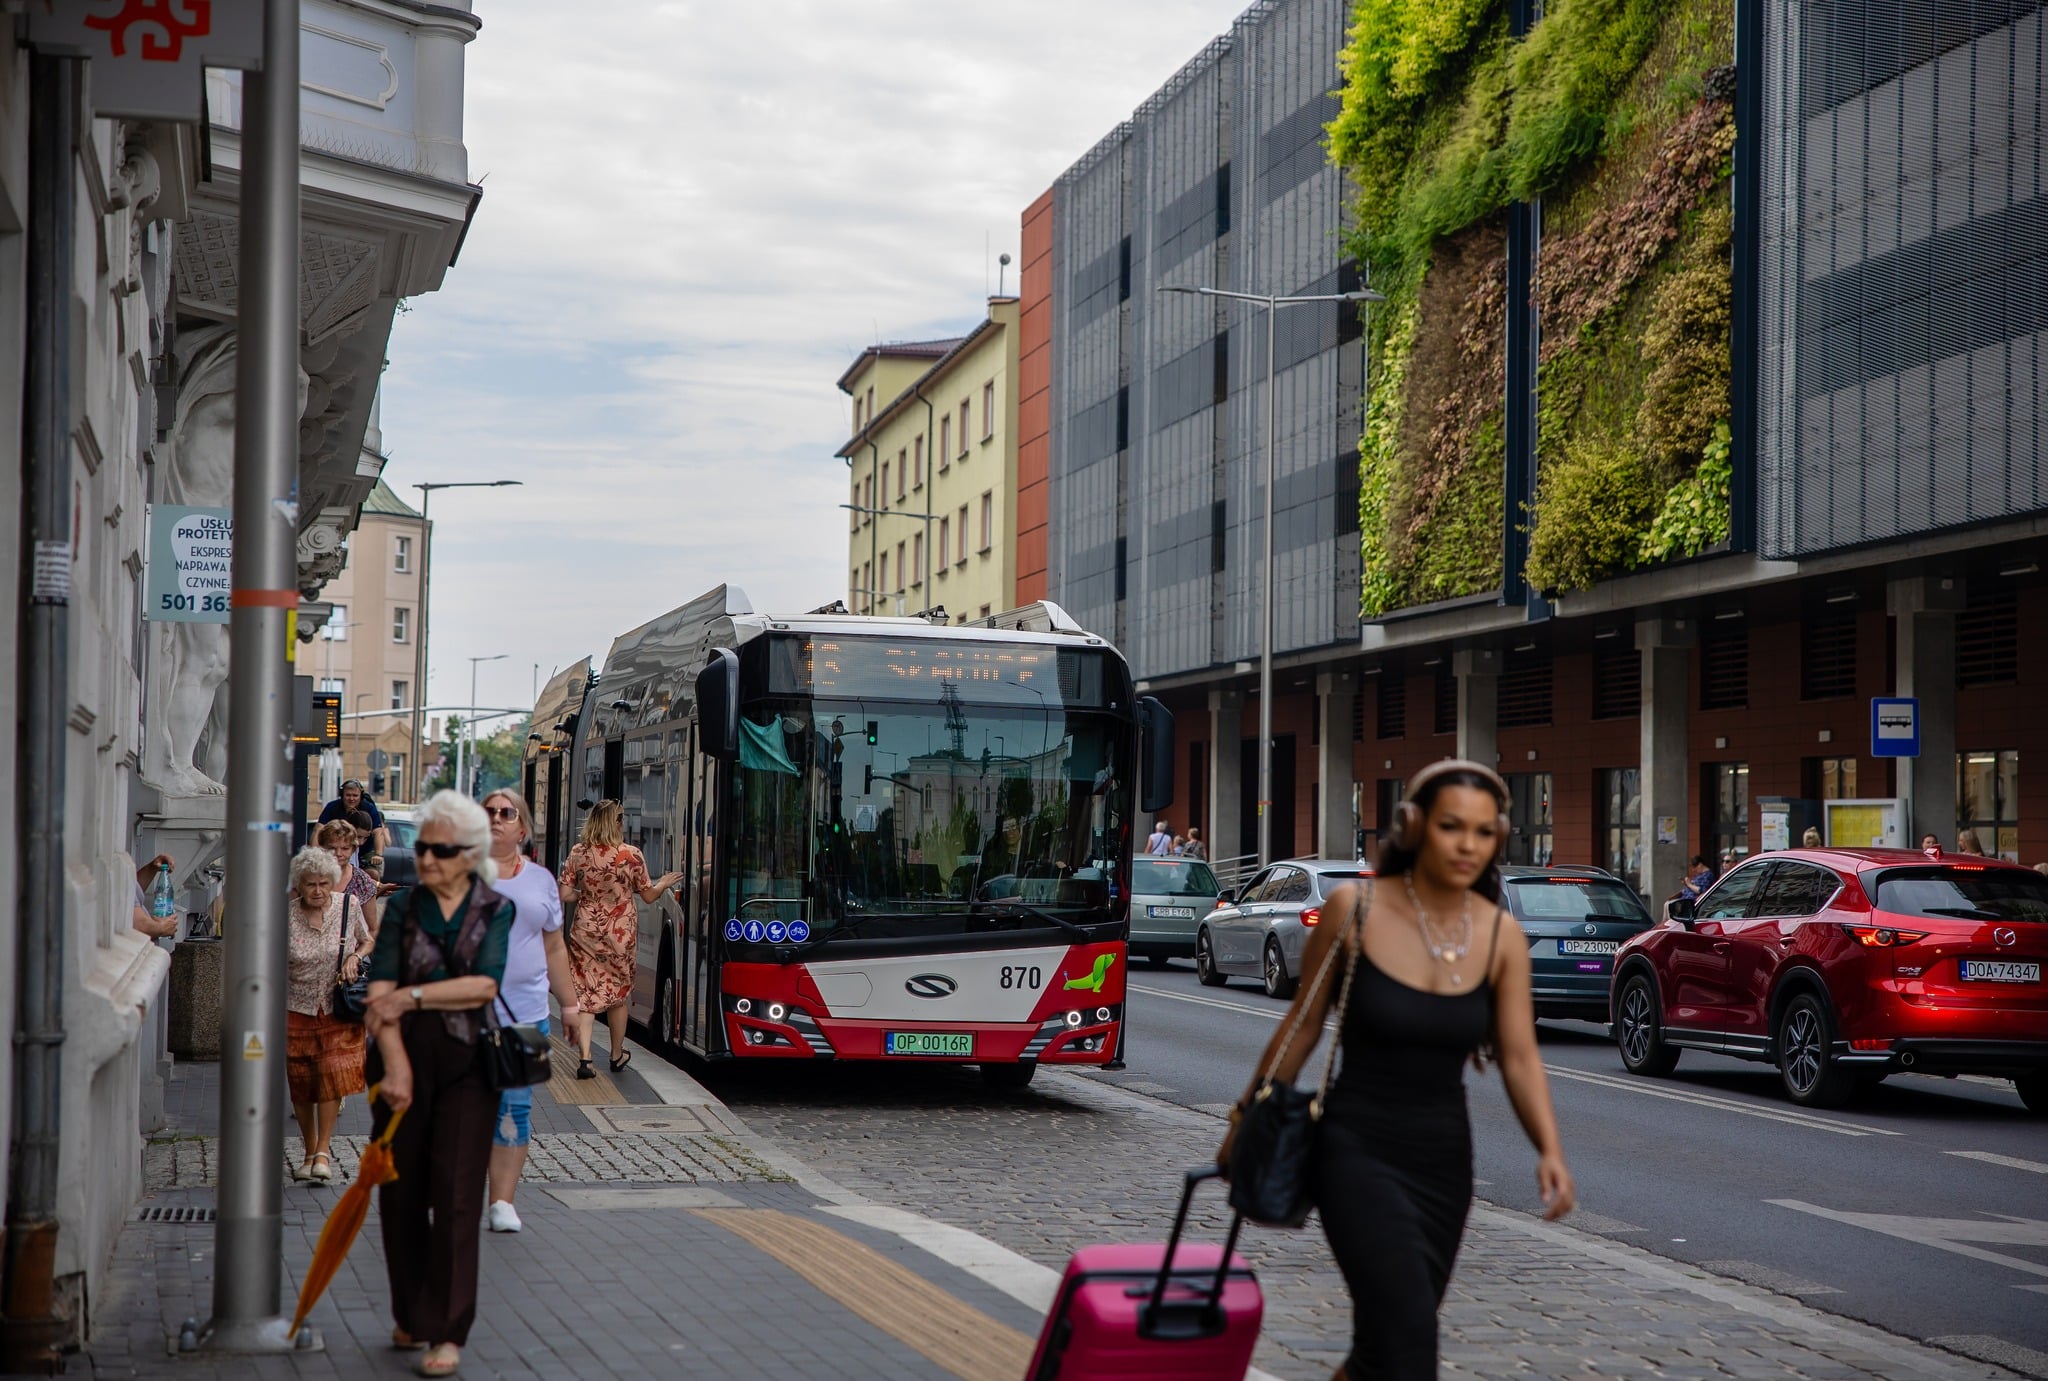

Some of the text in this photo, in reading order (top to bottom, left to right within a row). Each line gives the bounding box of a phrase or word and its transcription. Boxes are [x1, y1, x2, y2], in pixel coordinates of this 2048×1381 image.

[178, 528, 233, 540] PROTETY
[191, 546, 232, 558] EKSPRES
[176, 560, 226, 572] NAPRAWA
[161, 594, 195, 611] 501
[1566, 941, 1617, 953] OP 2309M
[1000, 966, 1041, 989] 870
[1968, 962, 1994, 978] DOA
[1998, 963, 2038, 979] 74347
[897, 1035, 917, 1050] OP
[922, 1035, 969, 1051] 0016R
